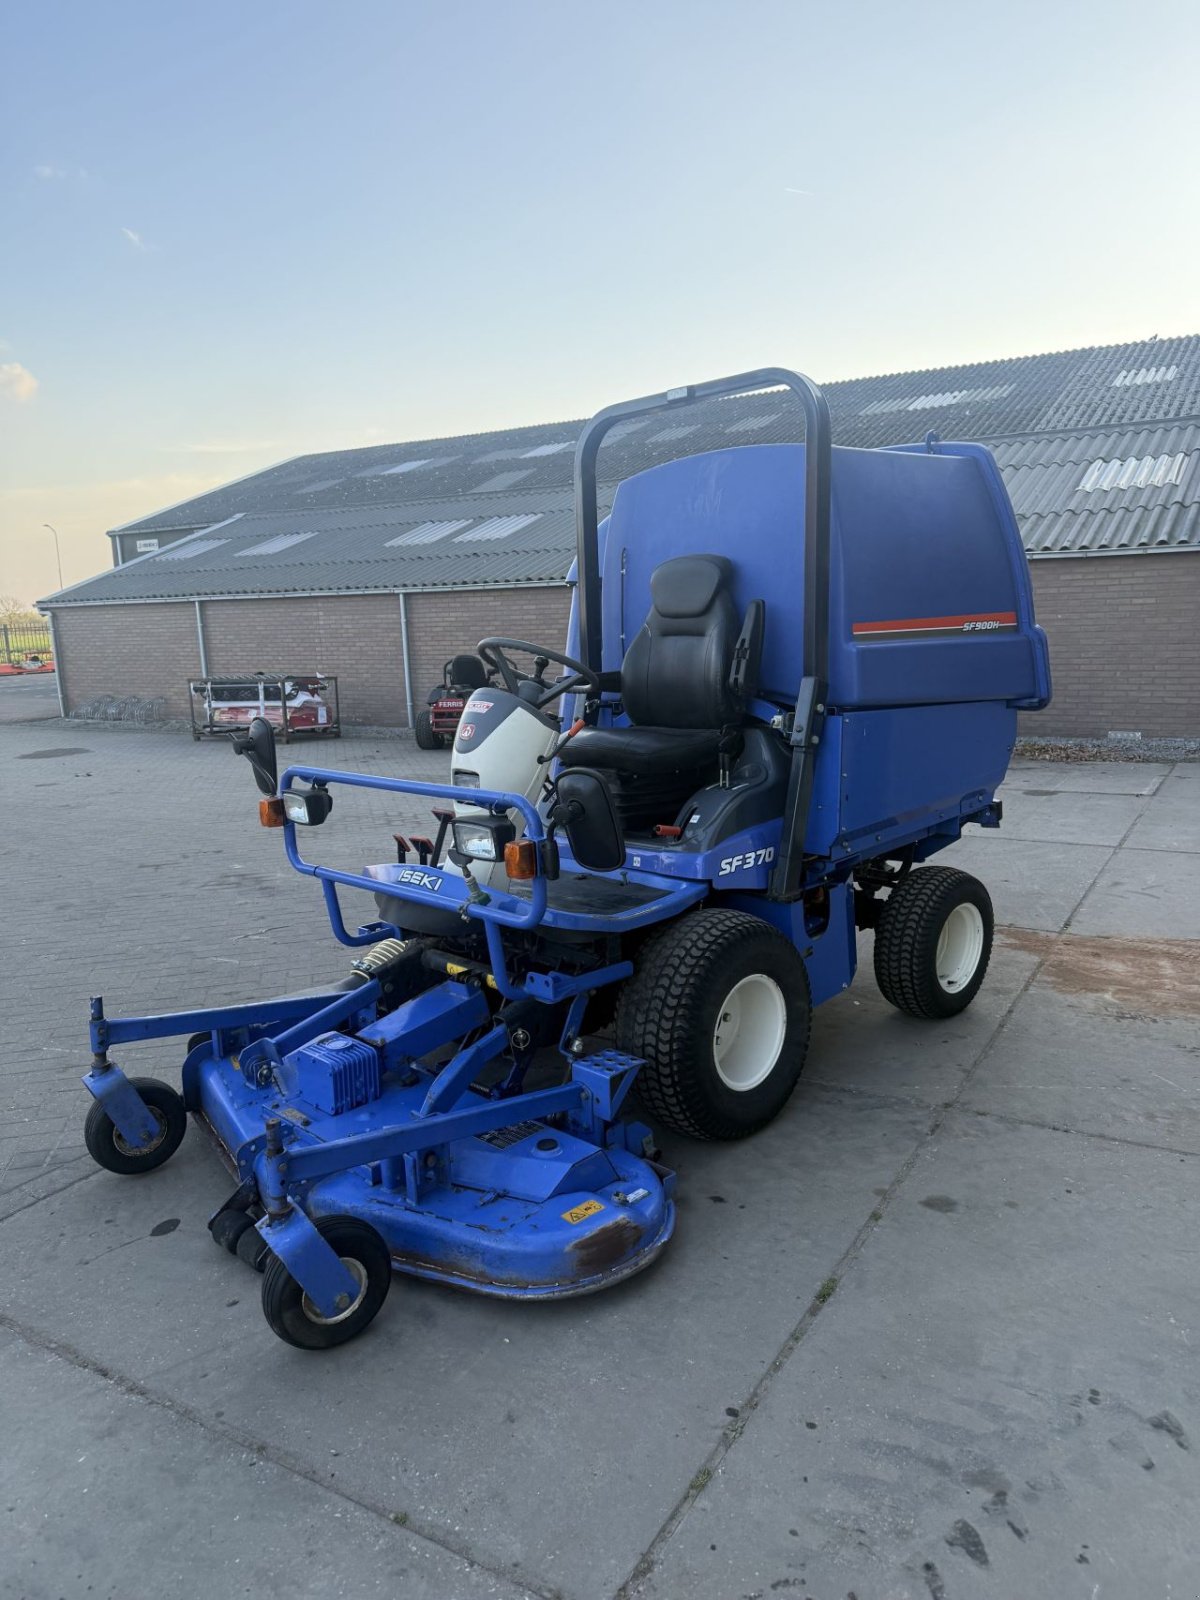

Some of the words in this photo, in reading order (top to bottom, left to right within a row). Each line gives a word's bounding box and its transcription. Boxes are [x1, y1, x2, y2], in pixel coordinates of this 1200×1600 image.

[962, 621, 999, 631] SF900H
[718, 846, 775, 876] SF370
[398, 869, 443, 891] ISEKI
